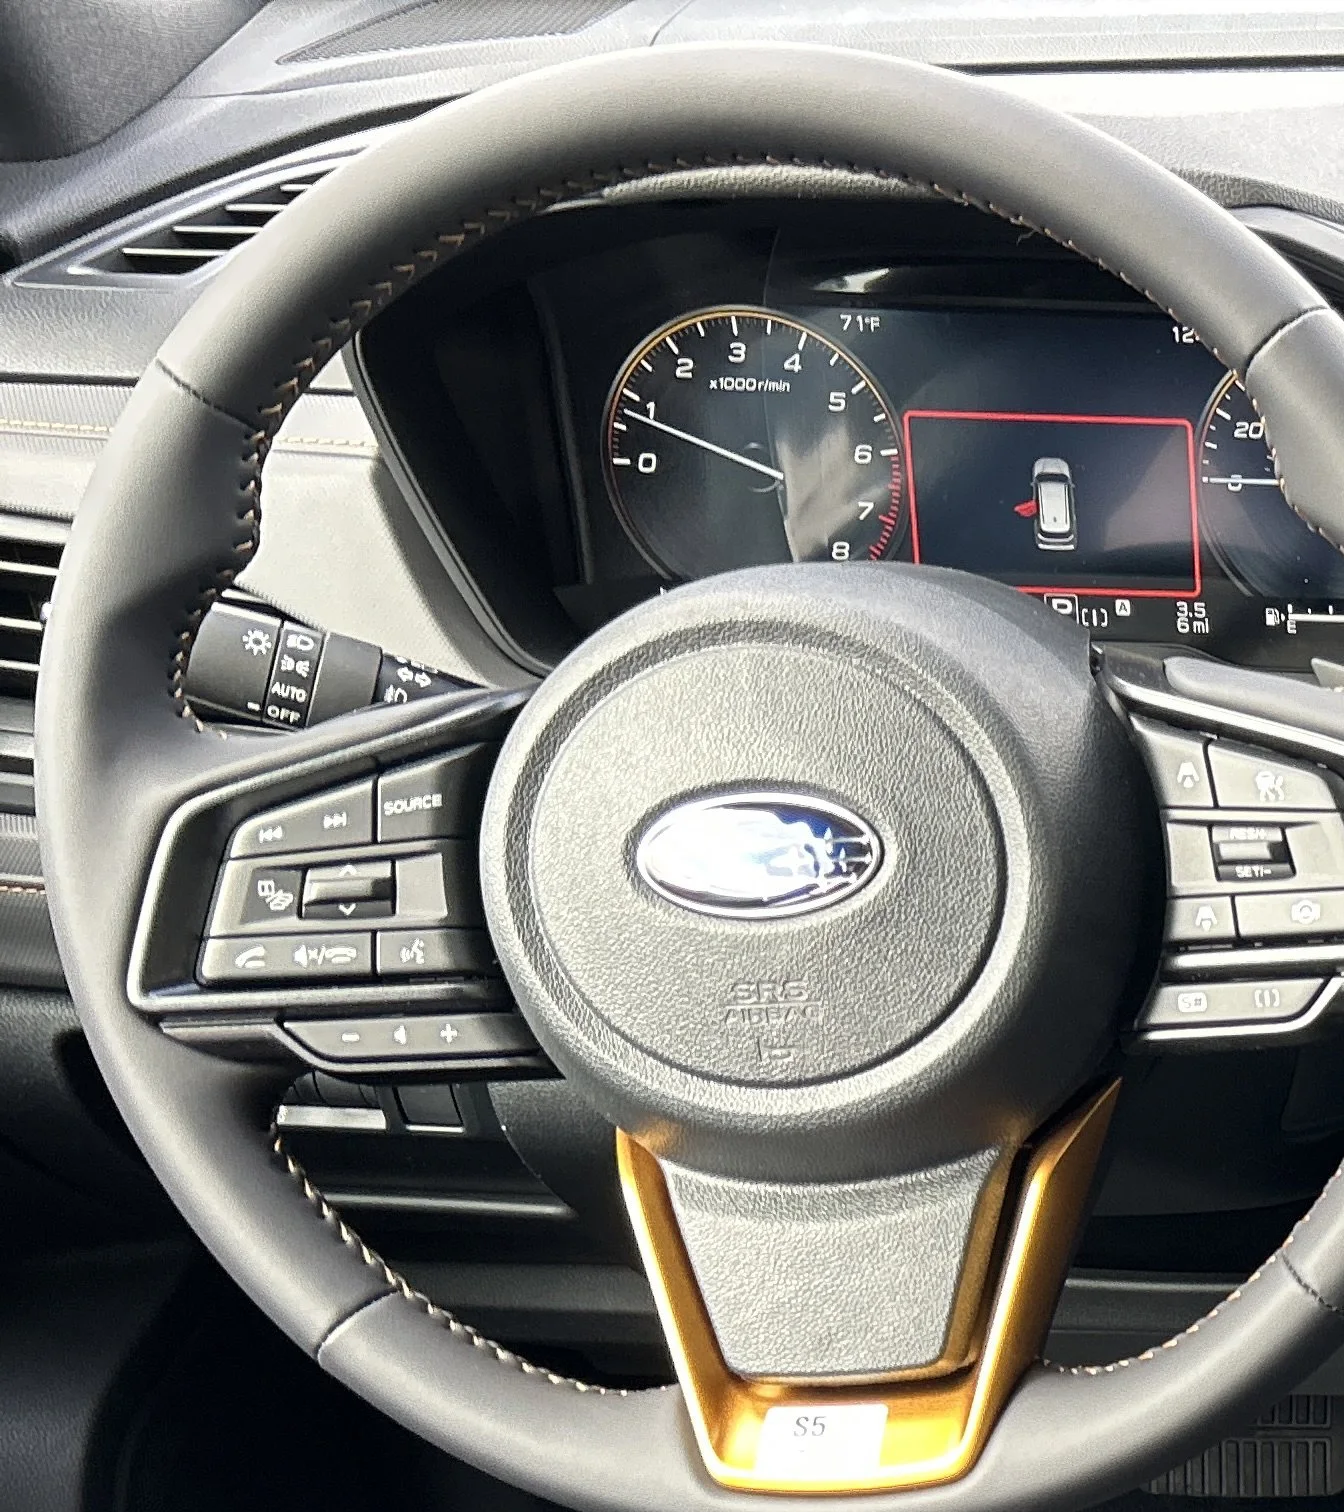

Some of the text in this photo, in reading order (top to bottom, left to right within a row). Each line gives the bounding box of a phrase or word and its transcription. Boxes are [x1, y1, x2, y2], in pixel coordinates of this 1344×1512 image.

[728, 342, 747, 363] 3
[675, 358, 694, 379] 2
[783, 353, 802, 373] 4
[646, 402, 657, 420] 1
[828, 392, 847, 412] 5
[1233, 421, 1264, 439] 20
[637, 452, 657, 474] 0
[854, 444, 873, 464] 6
[857, 502, 875, 521] 7
[831, 541, 850, 561] 8
[1176, 602, 1206, 618] 3.5
[1176, 617, 1209, 634] 6 mi
[270, 682, 307, 702] AUTO
[267, 705, 302, 725] OFF
[383, 793, 443, 817] SOURCE
[792, 1415, 826, 1438] S5
